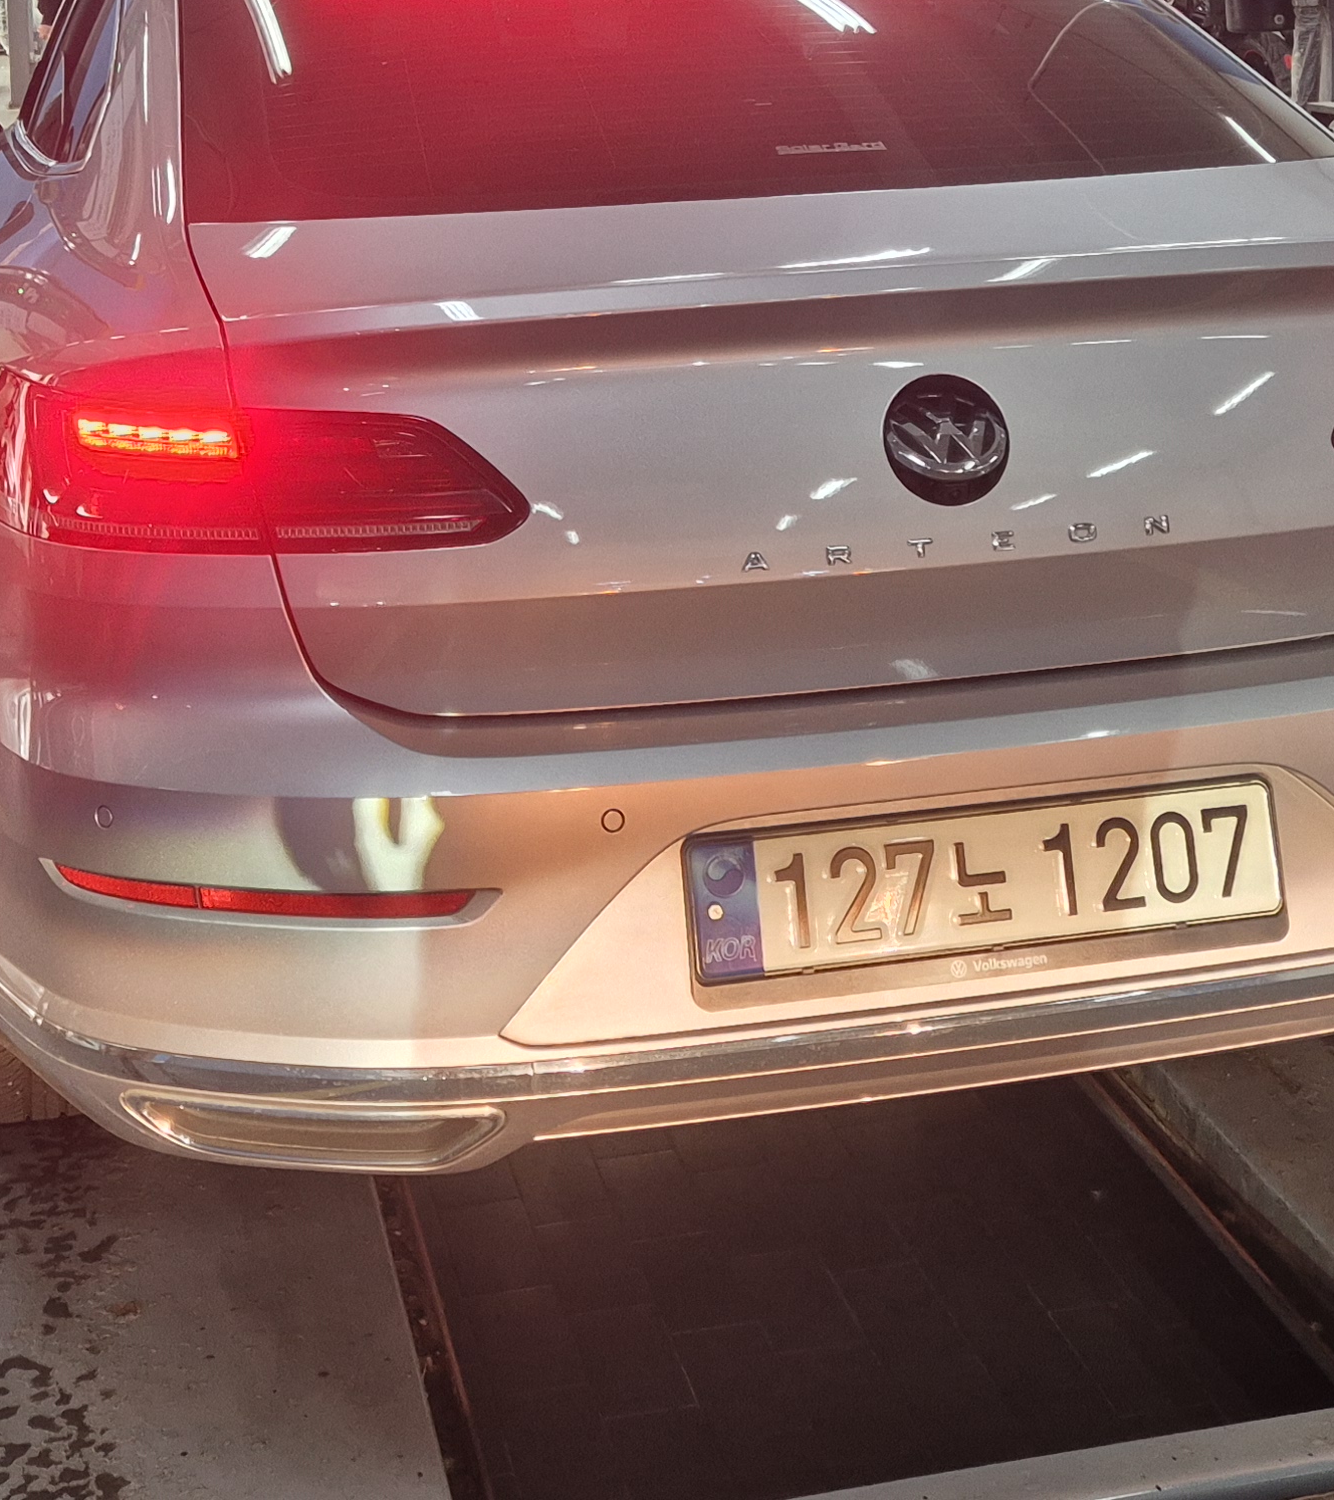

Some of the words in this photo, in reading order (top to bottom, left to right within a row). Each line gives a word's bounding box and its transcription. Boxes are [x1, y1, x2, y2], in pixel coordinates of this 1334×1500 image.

[741, 514, 1171, 573] ARTEON
[773, 838, 1014, 950] 127노
[1042, 804, 1249, 917] 1207
[705, 934, 757, 964] KOR
[972, 954, 1048, 972] Volkswagen
